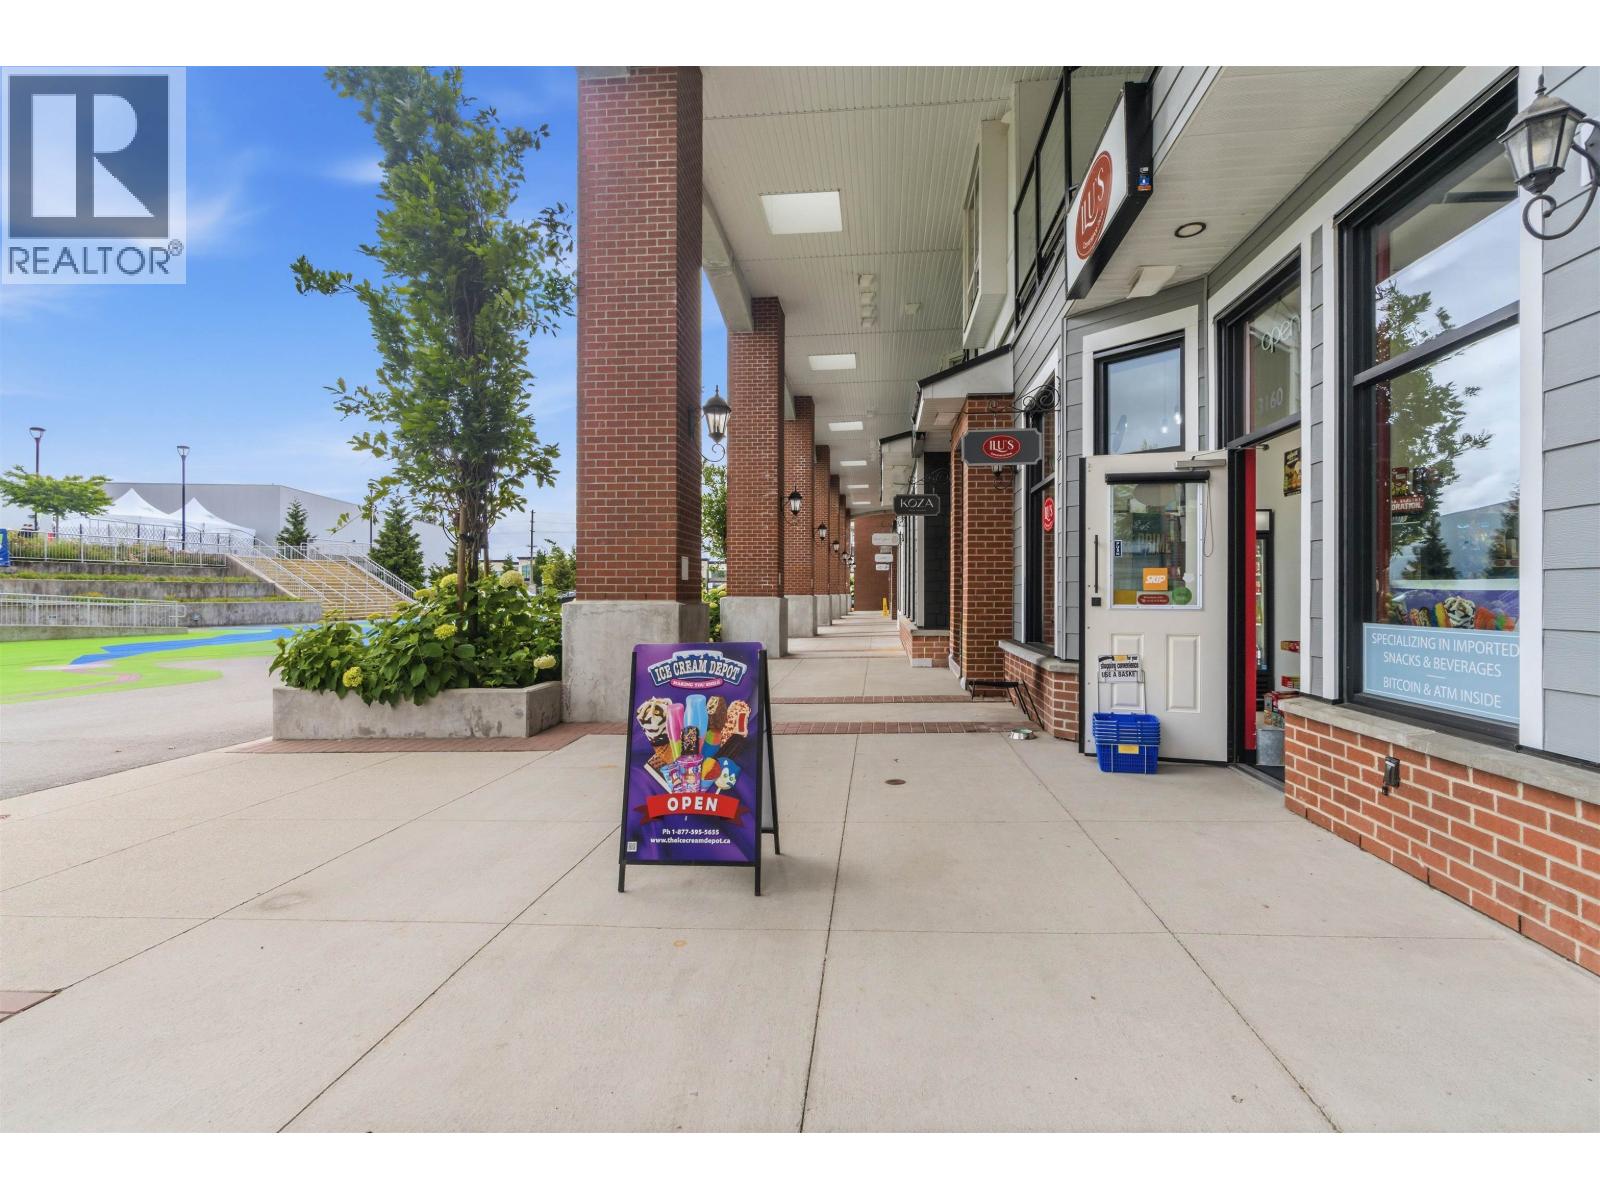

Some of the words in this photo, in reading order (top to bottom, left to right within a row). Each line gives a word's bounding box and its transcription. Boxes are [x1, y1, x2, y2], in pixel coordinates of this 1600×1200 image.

[989, 440, 1014, 453] ILU'S
[900, 498, 934, 508] KOZA
[1145, 575, 1166, 584] SKIP
[1371, 632, 1436, 650] SPECIALIZING
[1438, 639, 1450, 651] IN
[1453, 639, 1520, 658] IMPORTED
[654, 664, 672, 682] ICE
[673, 659, 707, 676] CREAM
[709, 661, 740, 681] DEPOT
[1383, 651, 1421, 668] SNACKS
[1423, 656, 1431, 668] &
[1433, 657, 1502, 677] BEVERAGES
[1383, 676, 1421, 695] BITCOIN
[1423, 683, 1432, 696] &
[1433, 685, 1457, 700] ATM
[1461, 690, 1502, 709] INSIDE
[667, 796, 718, 812] OPEN
[650, 837, 731, 845] www.theicecreamdepot.ca
